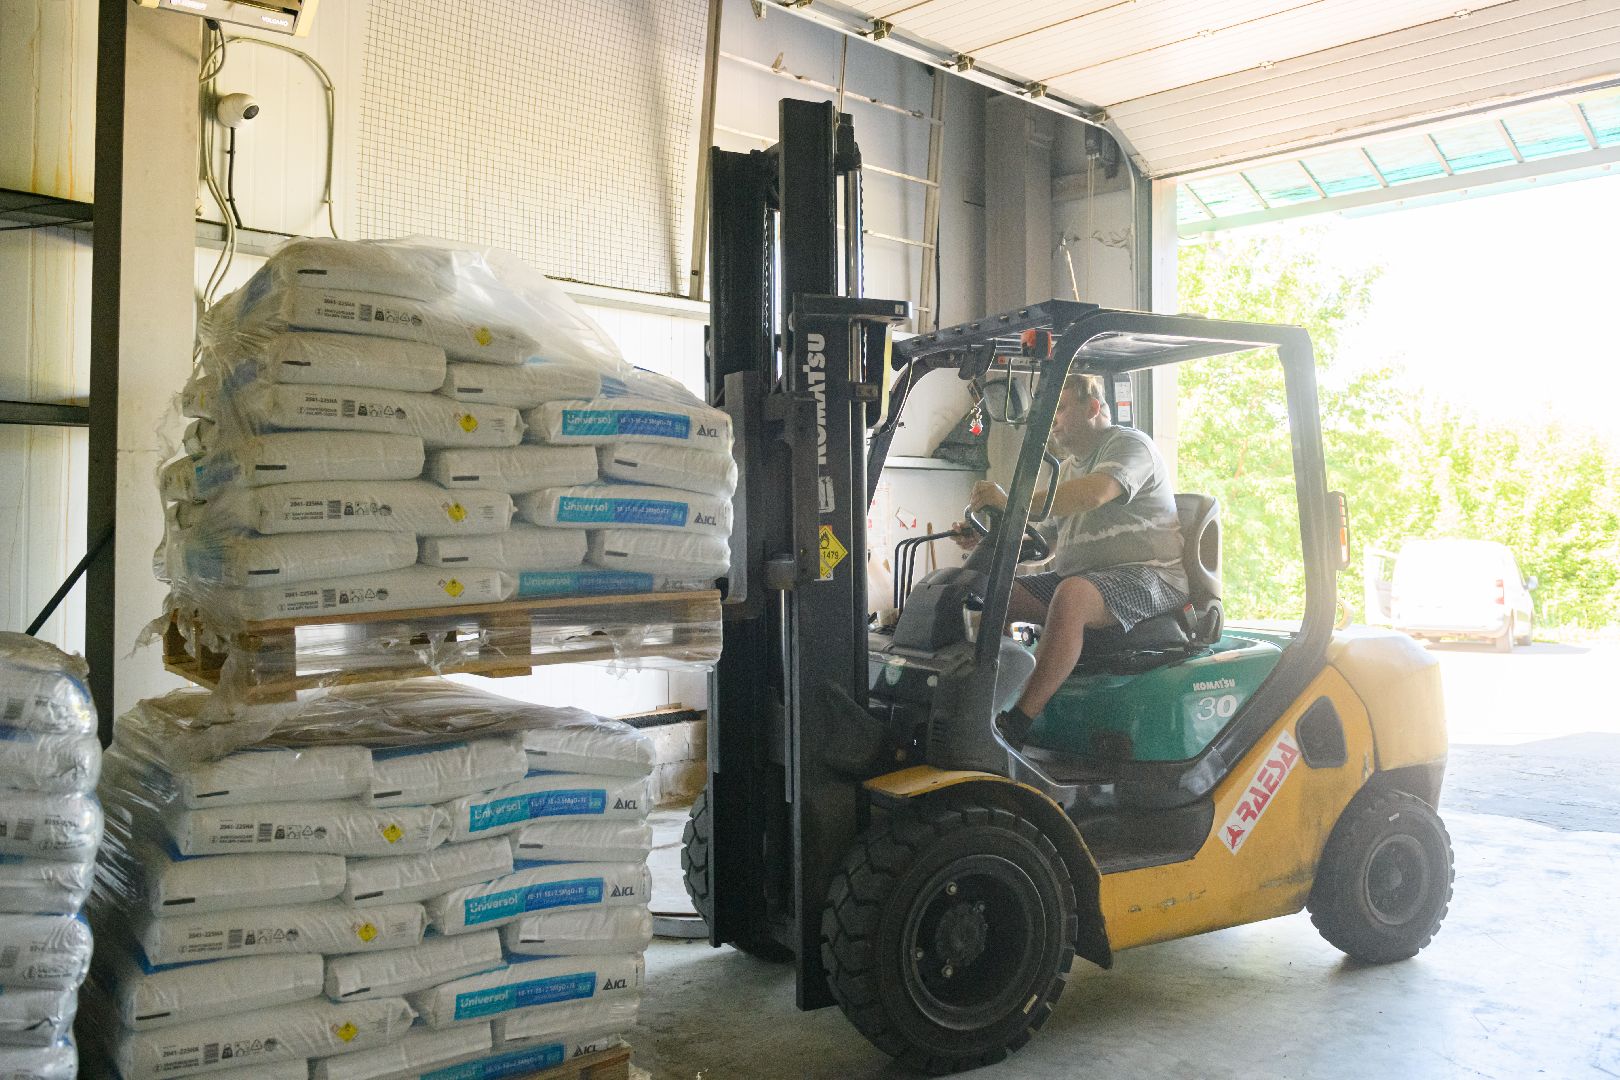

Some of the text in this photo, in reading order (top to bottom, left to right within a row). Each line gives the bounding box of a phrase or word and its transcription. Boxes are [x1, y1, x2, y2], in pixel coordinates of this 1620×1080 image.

[563, 502, 608, 512] Universol
[823, 551, 838, 559] 1479
[1193, 678, 1235, 690] KOMATSU
[1197, 695, 1237, 720] 30
[624, 800, 638, 809] ICL
[621, 886, 634, 896] ICL
[470, 894, 518, 913] Universol
[613, 978, 627, 988] ICL
[460, 990, 509, 1008] Universol
